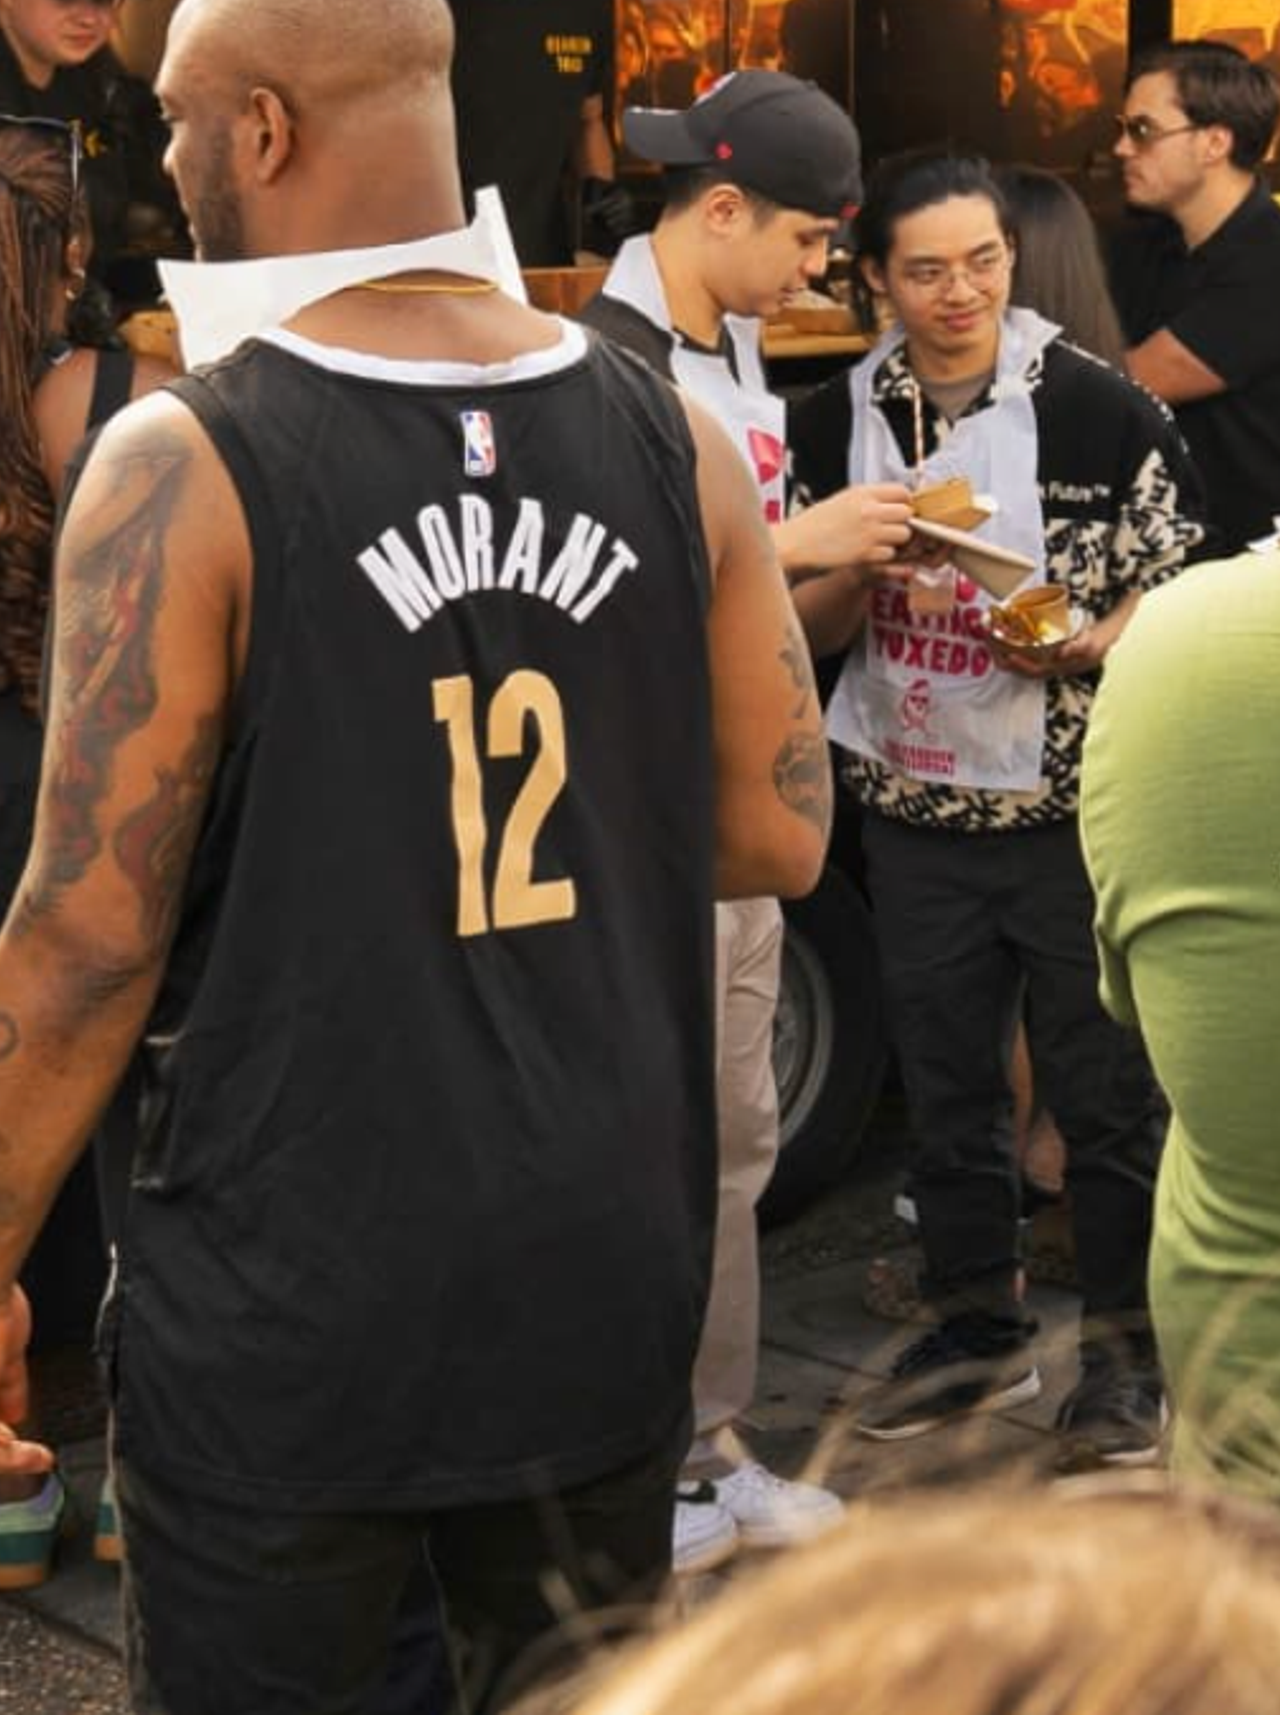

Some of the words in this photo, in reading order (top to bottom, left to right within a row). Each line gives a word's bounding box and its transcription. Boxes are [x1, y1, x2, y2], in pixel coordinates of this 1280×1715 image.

[356, 493, 639, 633] MORANT
[873, 626, 991, 677] TUXEDO
[431, 668, 576, 936] 12
